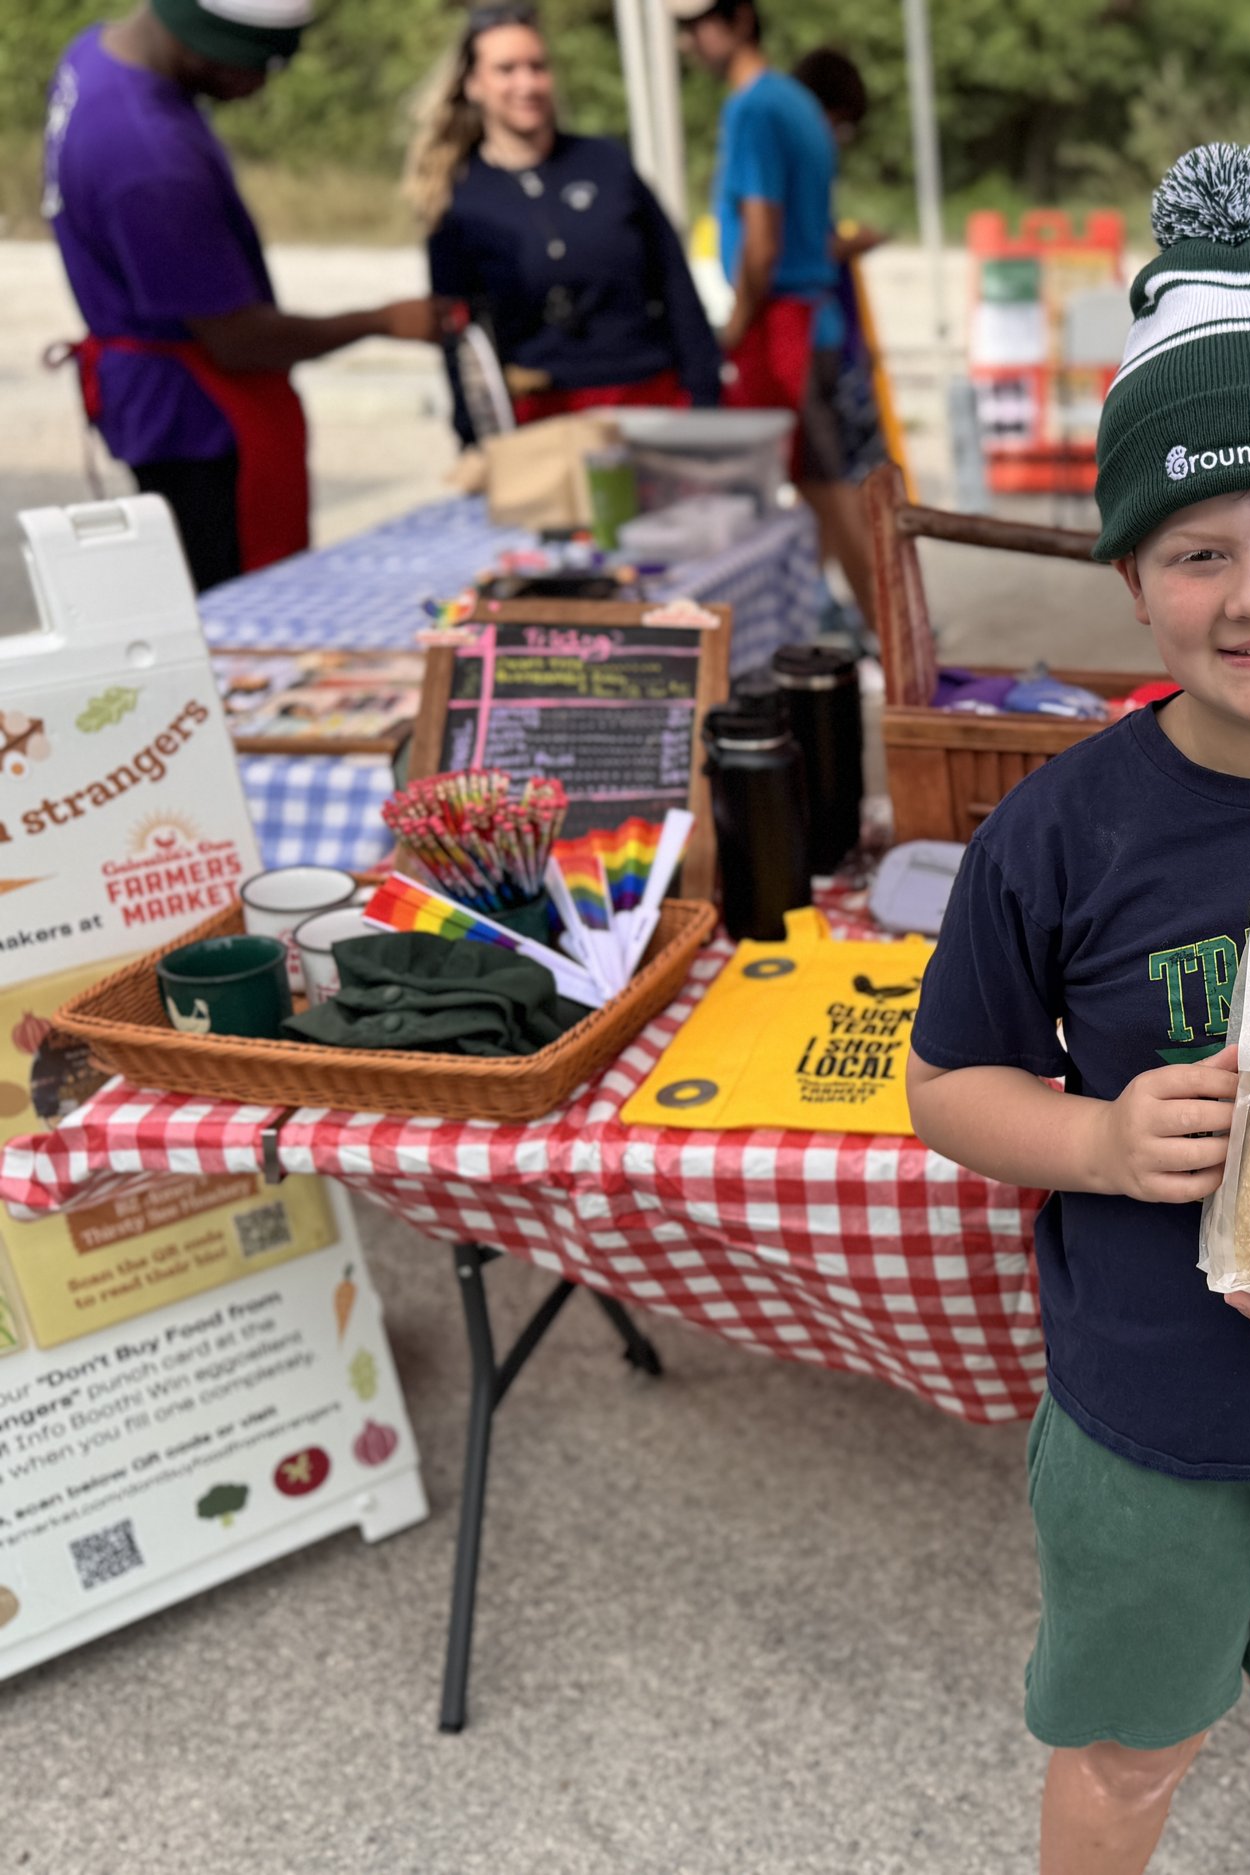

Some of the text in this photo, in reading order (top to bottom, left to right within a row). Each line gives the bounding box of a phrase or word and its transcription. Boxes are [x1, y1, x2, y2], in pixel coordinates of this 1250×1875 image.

[22, 699, 210, 836] strangers
[106, 853, 242, 905] FARMERS
[79, 914, 103, 931] at
[122, 880, 238, 928] MARKET
[827, 1001, 917, 1023] CLUCK
[830, 1020, 898, 1037] YEAH
[825, 1038, 903, 1054] SHOP
[796, 1054, 896, 1079] LOCAL
[115, 1337, 160, 1363] Buy
[165, 1310, 223, 1343] Food
[227, 1292, 284, 1320] from
[0, 1318, 277, 1432] ngers" punch card at the
[8, 1444, 75, 1479] when
[78, 1426, 121, 1456] you
[124, 1411, 151, 1433] fill
[154, 1396, 195, 1423] one
[15, 1422, 67, 1452] Info
